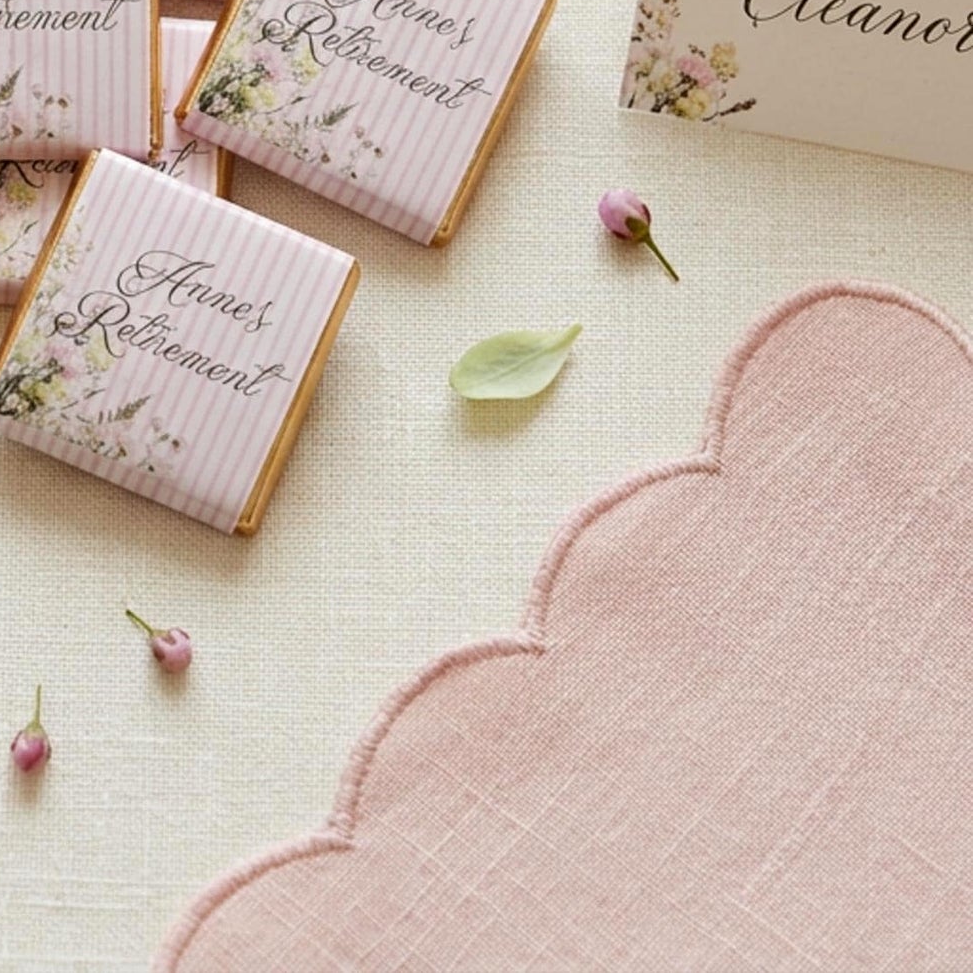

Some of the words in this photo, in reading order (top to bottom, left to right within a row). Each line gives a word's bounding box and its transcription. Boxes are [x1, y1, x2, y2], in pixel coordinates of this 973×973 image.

[253, 0, 493, 110] Retirement
[49, 290, 294, 398] Retirement
[116, 249, 275, 334] Anne's
